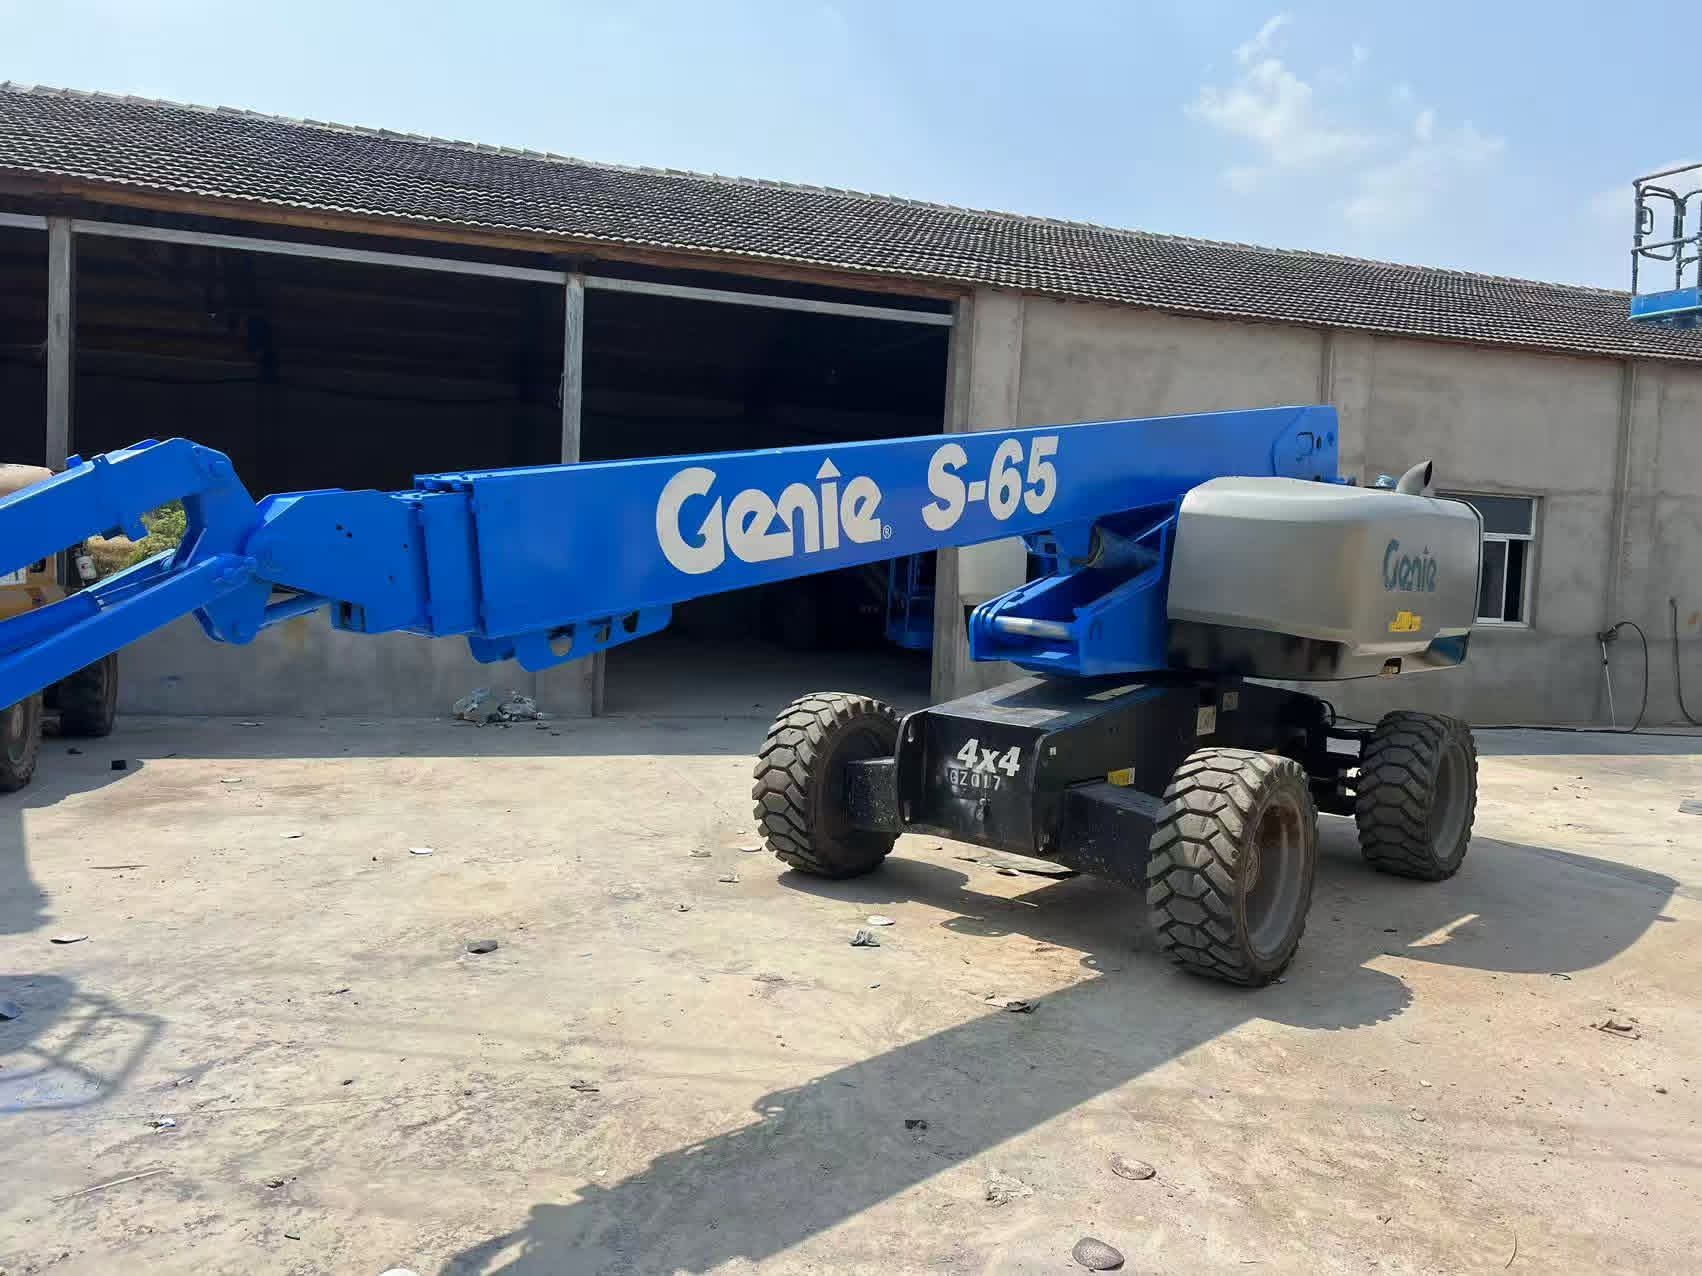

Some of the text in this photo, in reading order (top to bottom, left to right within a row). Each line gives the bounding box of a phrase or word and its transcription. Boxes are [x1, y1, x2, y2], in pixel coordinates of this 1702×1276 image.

[922, 436, 1059, 531] S-65
[1383, 538, 1437, 592] Genie
[957, 738, 1021, 776] 4x4
